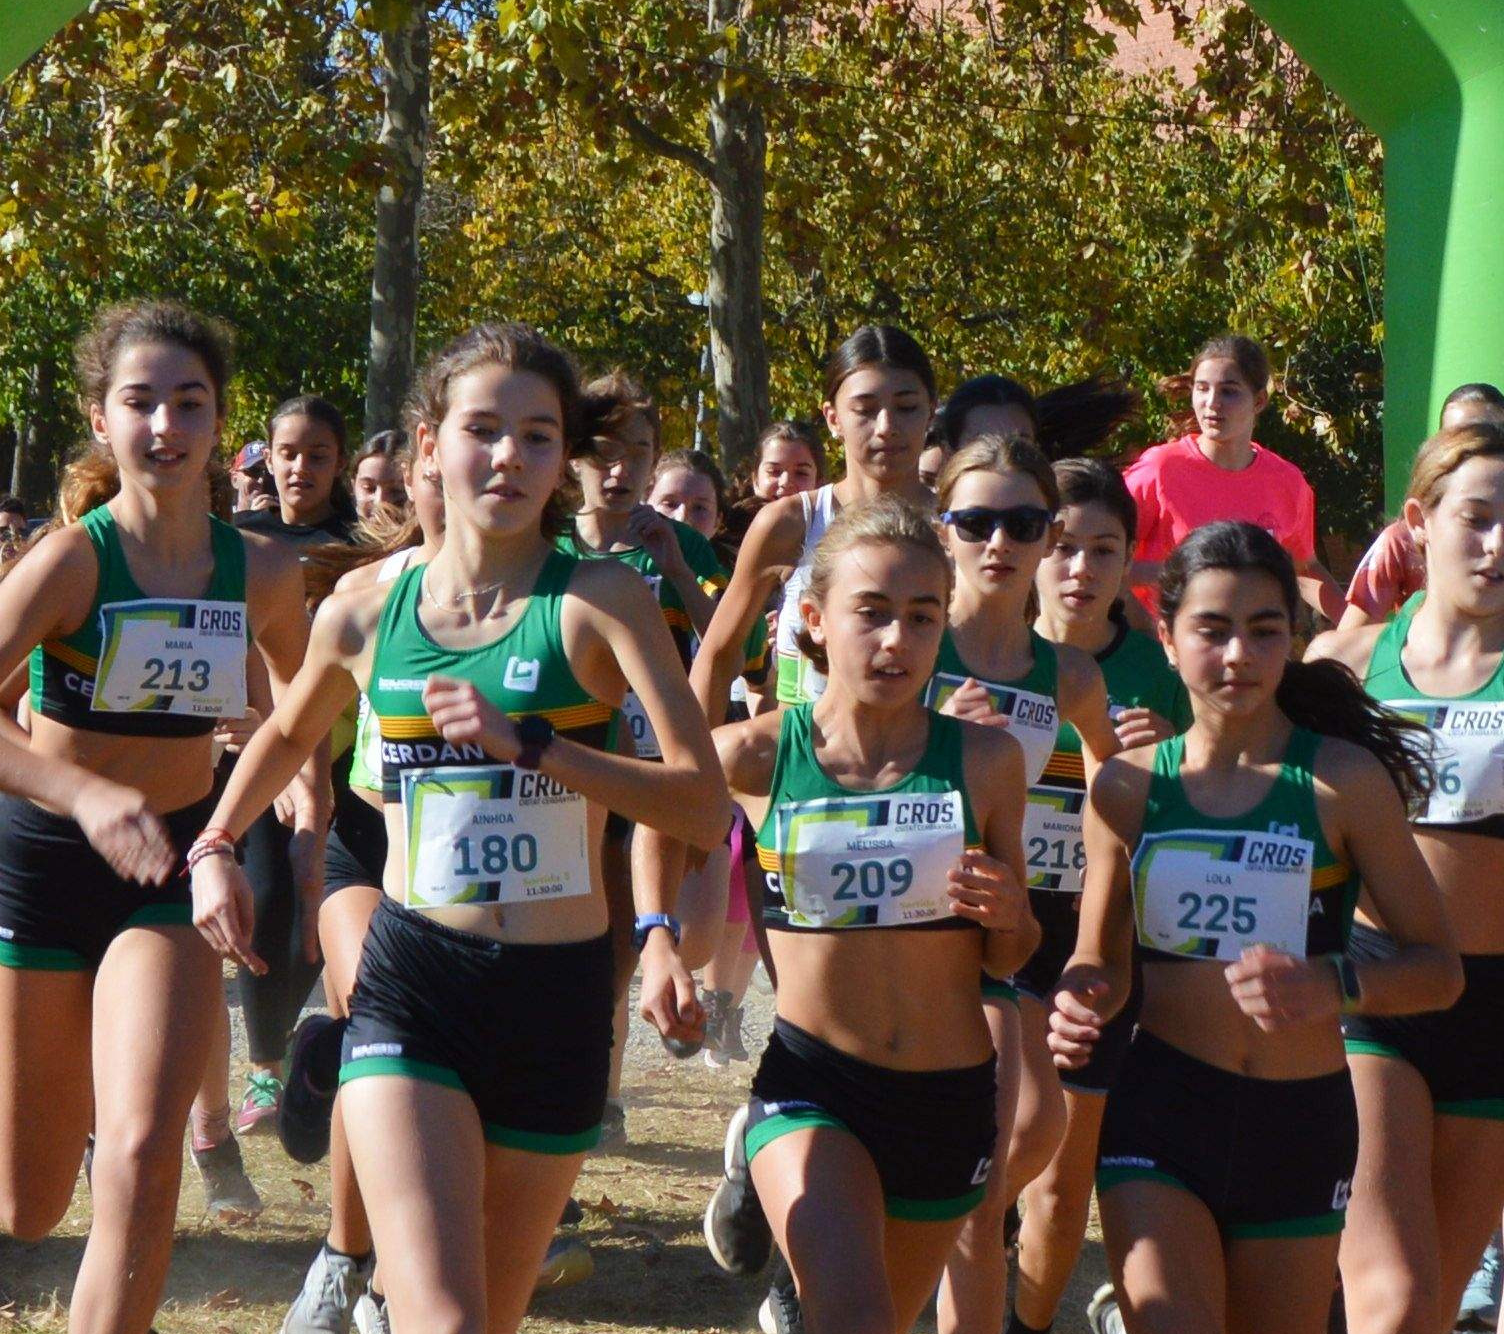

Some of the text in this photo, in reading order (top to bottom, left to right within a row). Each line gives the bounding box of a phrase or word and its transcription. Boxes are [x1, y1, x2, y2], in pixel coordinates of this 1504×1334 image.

[199, 609, 242, 630] CROS
[165, 640, 193, 650] MARIA
[141, 658, 211, 692] 213
[1016, 698, 1056, 725] CROS
[382, 741, 485, 765] CERDAN
[472, 814, 515, 825] AINHOA
[896, 802, 954, 825] CROS
[1043, 821, 1083, 834] MARIONA
[453, 833, 538, 877] 180
[846, 839, 895, 851] MELISSA
[1027, 836, 1088, 870] 218
[1247, 840, 1307, 867] CROS
[831, 858, 914, 901] 209
[1206, 873, 1232, 885] LOLA
[1177, 891, 1258, 935] 225
